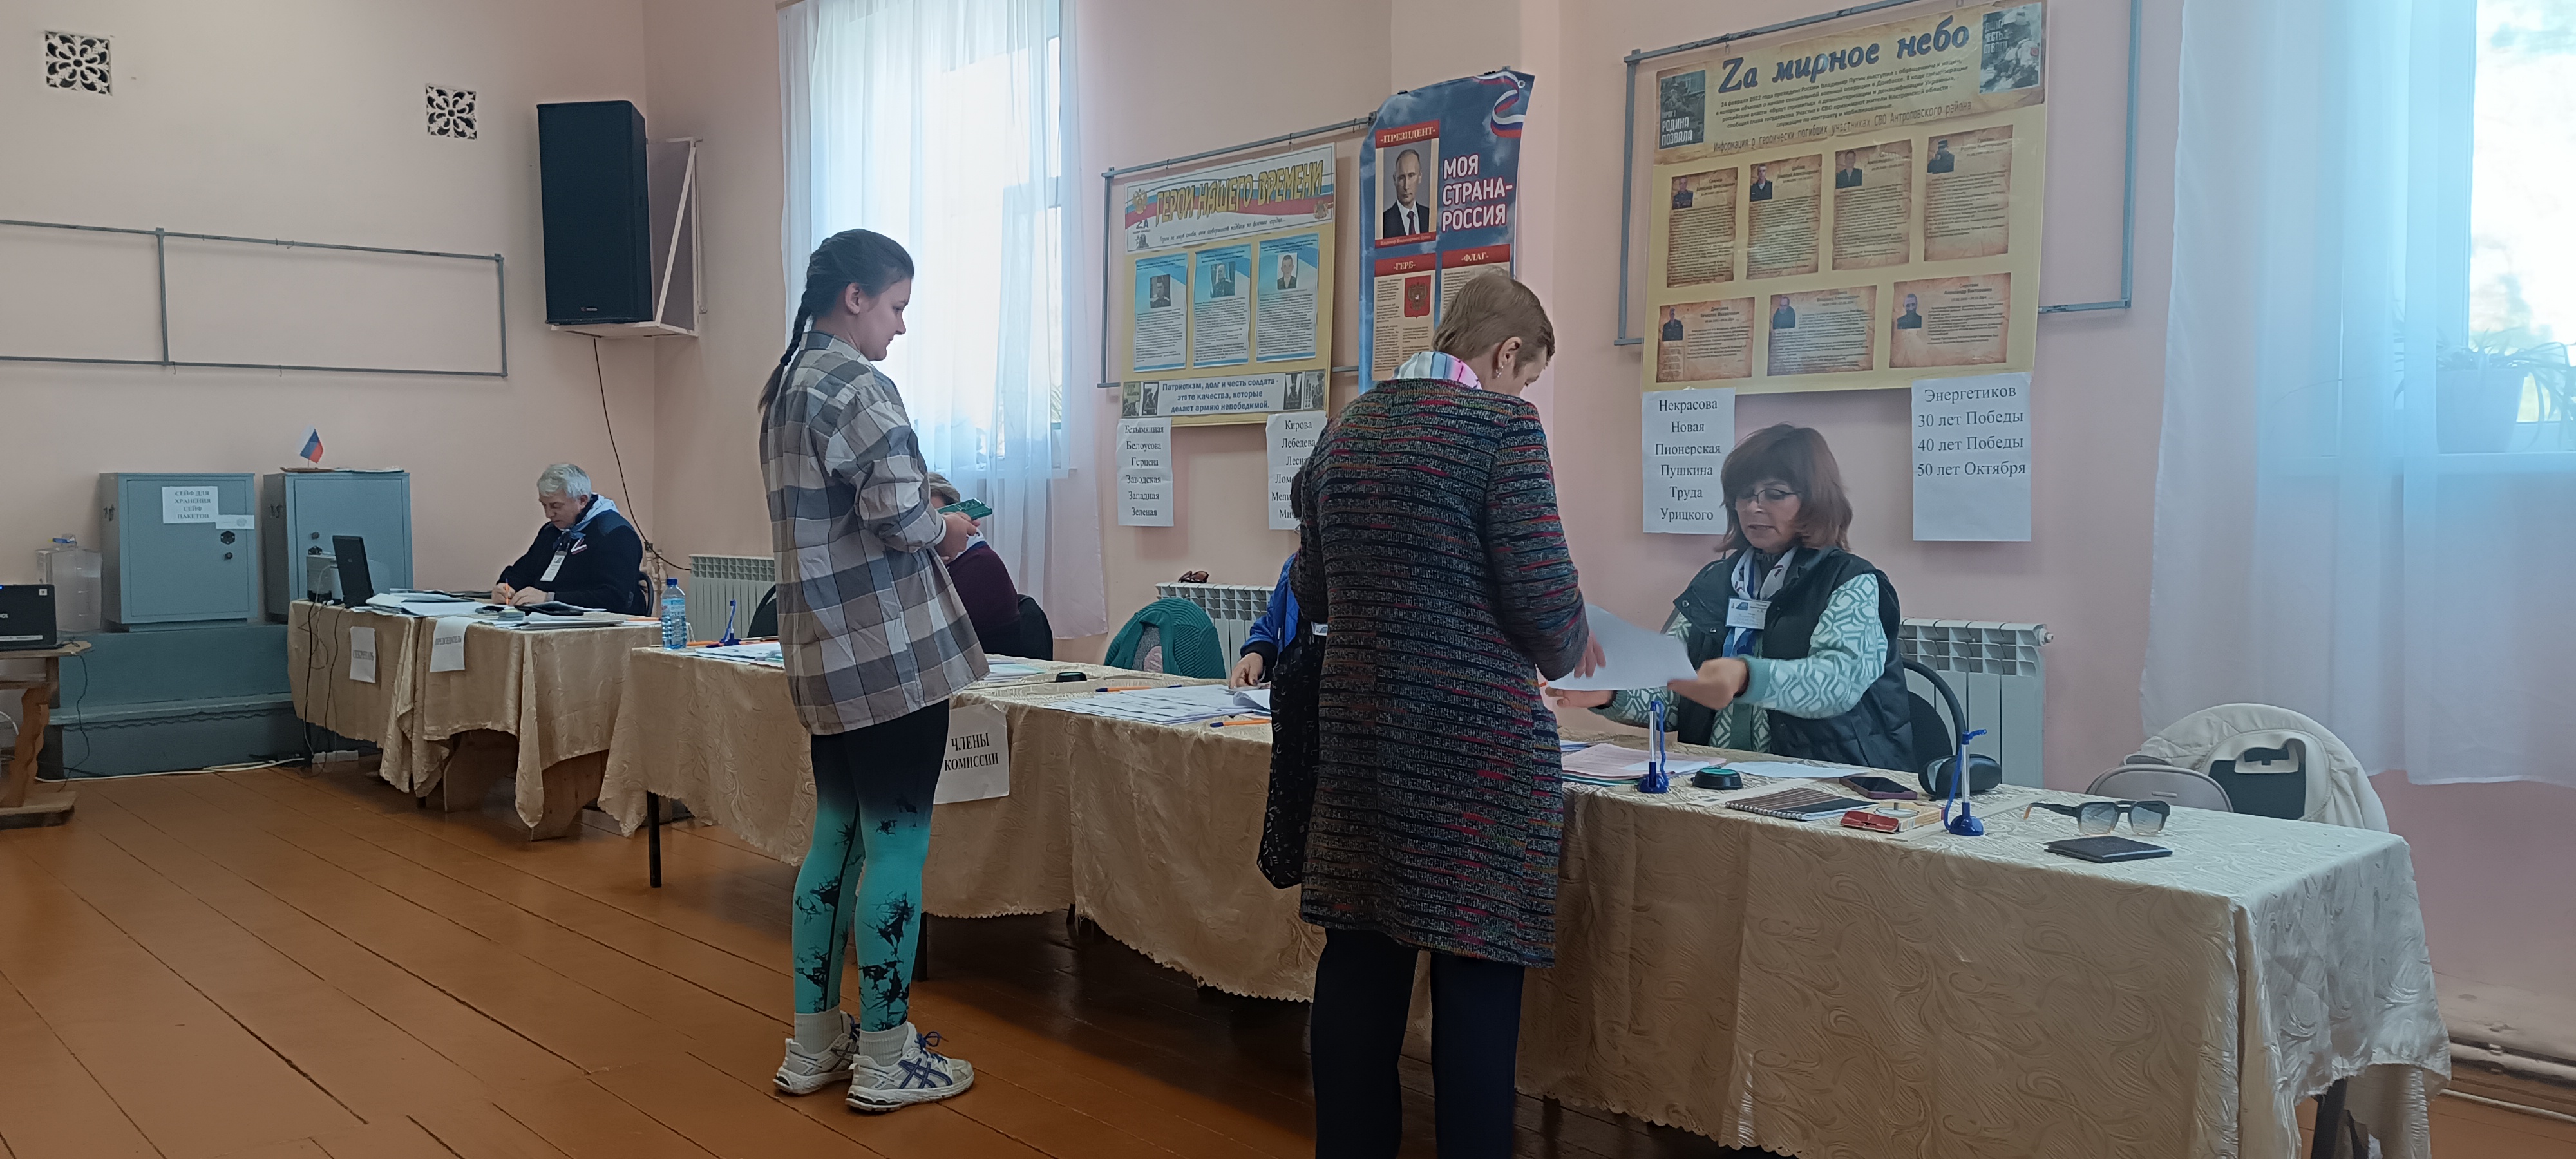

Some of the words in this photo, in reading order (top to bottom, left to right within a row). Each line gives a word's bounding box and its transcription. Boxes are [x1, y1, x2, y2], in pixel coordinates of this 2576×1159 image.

[1772, 43, 1880, 83] мирное
[1897, 15, 1969, 59] небо
[1662, 117, 1689, 133] РОДИНА
[1713, 138, 1748, 153] Информация
[1751, 138, 1756, 146] о
[1759, 131, 1795, 146] героически
[1797, 124, 1828, 137] погибших
[1832, 118, 1870, 136] участниках
[1875, 115, 1886, 126] СВО
[1890, 106, 1942, 124] Антроповского
[1946, 100, 1972, 117] района
[1662, 130, 1692, 146] ПОЗВАЛА
[1444, 155, 1479, 180] МОЯ
[1155, 185, 1195, 226] ГЕРОИ
[1197, 174, 1253, 220] НАШЕГО
[1258, 160, 1323, 206] ВРЕМЕНИ
[1443, 177, 1513, 205] СТРАНА-
[1442, 204, 1506, 232] РОССИЯ
[1162, 382, 1204, 392] Патриотизм,
[1248, 377, 1275, 386] солдата
[1197, 391, 1231, 400] качества,
[1233, 390, 1262, 400] которые
[1924, 387, 2016, 404] Энергетиков
[1171, 405, 1193, 413] делают
[1195, 404, 1219, 413] армию
[1221, 400, 1269, 411] непобедимой.
[1659, 400, 1718, 413] Некрасова
[1918, 414, 1934, 427] 30
[1938, 416, 1962, 426] лет
[1966, 410, 2023, 424] Победы
[1285, 420, 1312, 432] Кирова
[1671, 421, 1705, 433] Новая
[1126, 441, 1161, 452] Белоусова
[1282, 438, 1315, 450] Лебедева
[1655, 444, 1721, 456] Пионерская
[1918, 439, 1934, 451] 40
[1938, 440, 1962, 451] лет
[1966, 435, 2023, 449] Победы
[1131, 457, 1159, 469] Герцена
[1917, 463, 1933, 476] 50
[1937, 465, 1960, 476] лет
[1964, 460, 2026, 477] Октября
[1661, 464, 1713, 478] Пушкина
[1126, 475, 1161, 484] Заводская
[1128, 491, 1159, 500] Западная
[1669, 486, 1703, 500] Труда
[1132, 507, 1157, 516] Зеленая
[1660, 508, 1714, 522] Урицкого
[951, 733, 990, 751] ЧЛЕНЫ
[944, 753, 999, 771] КОМИССИИ
